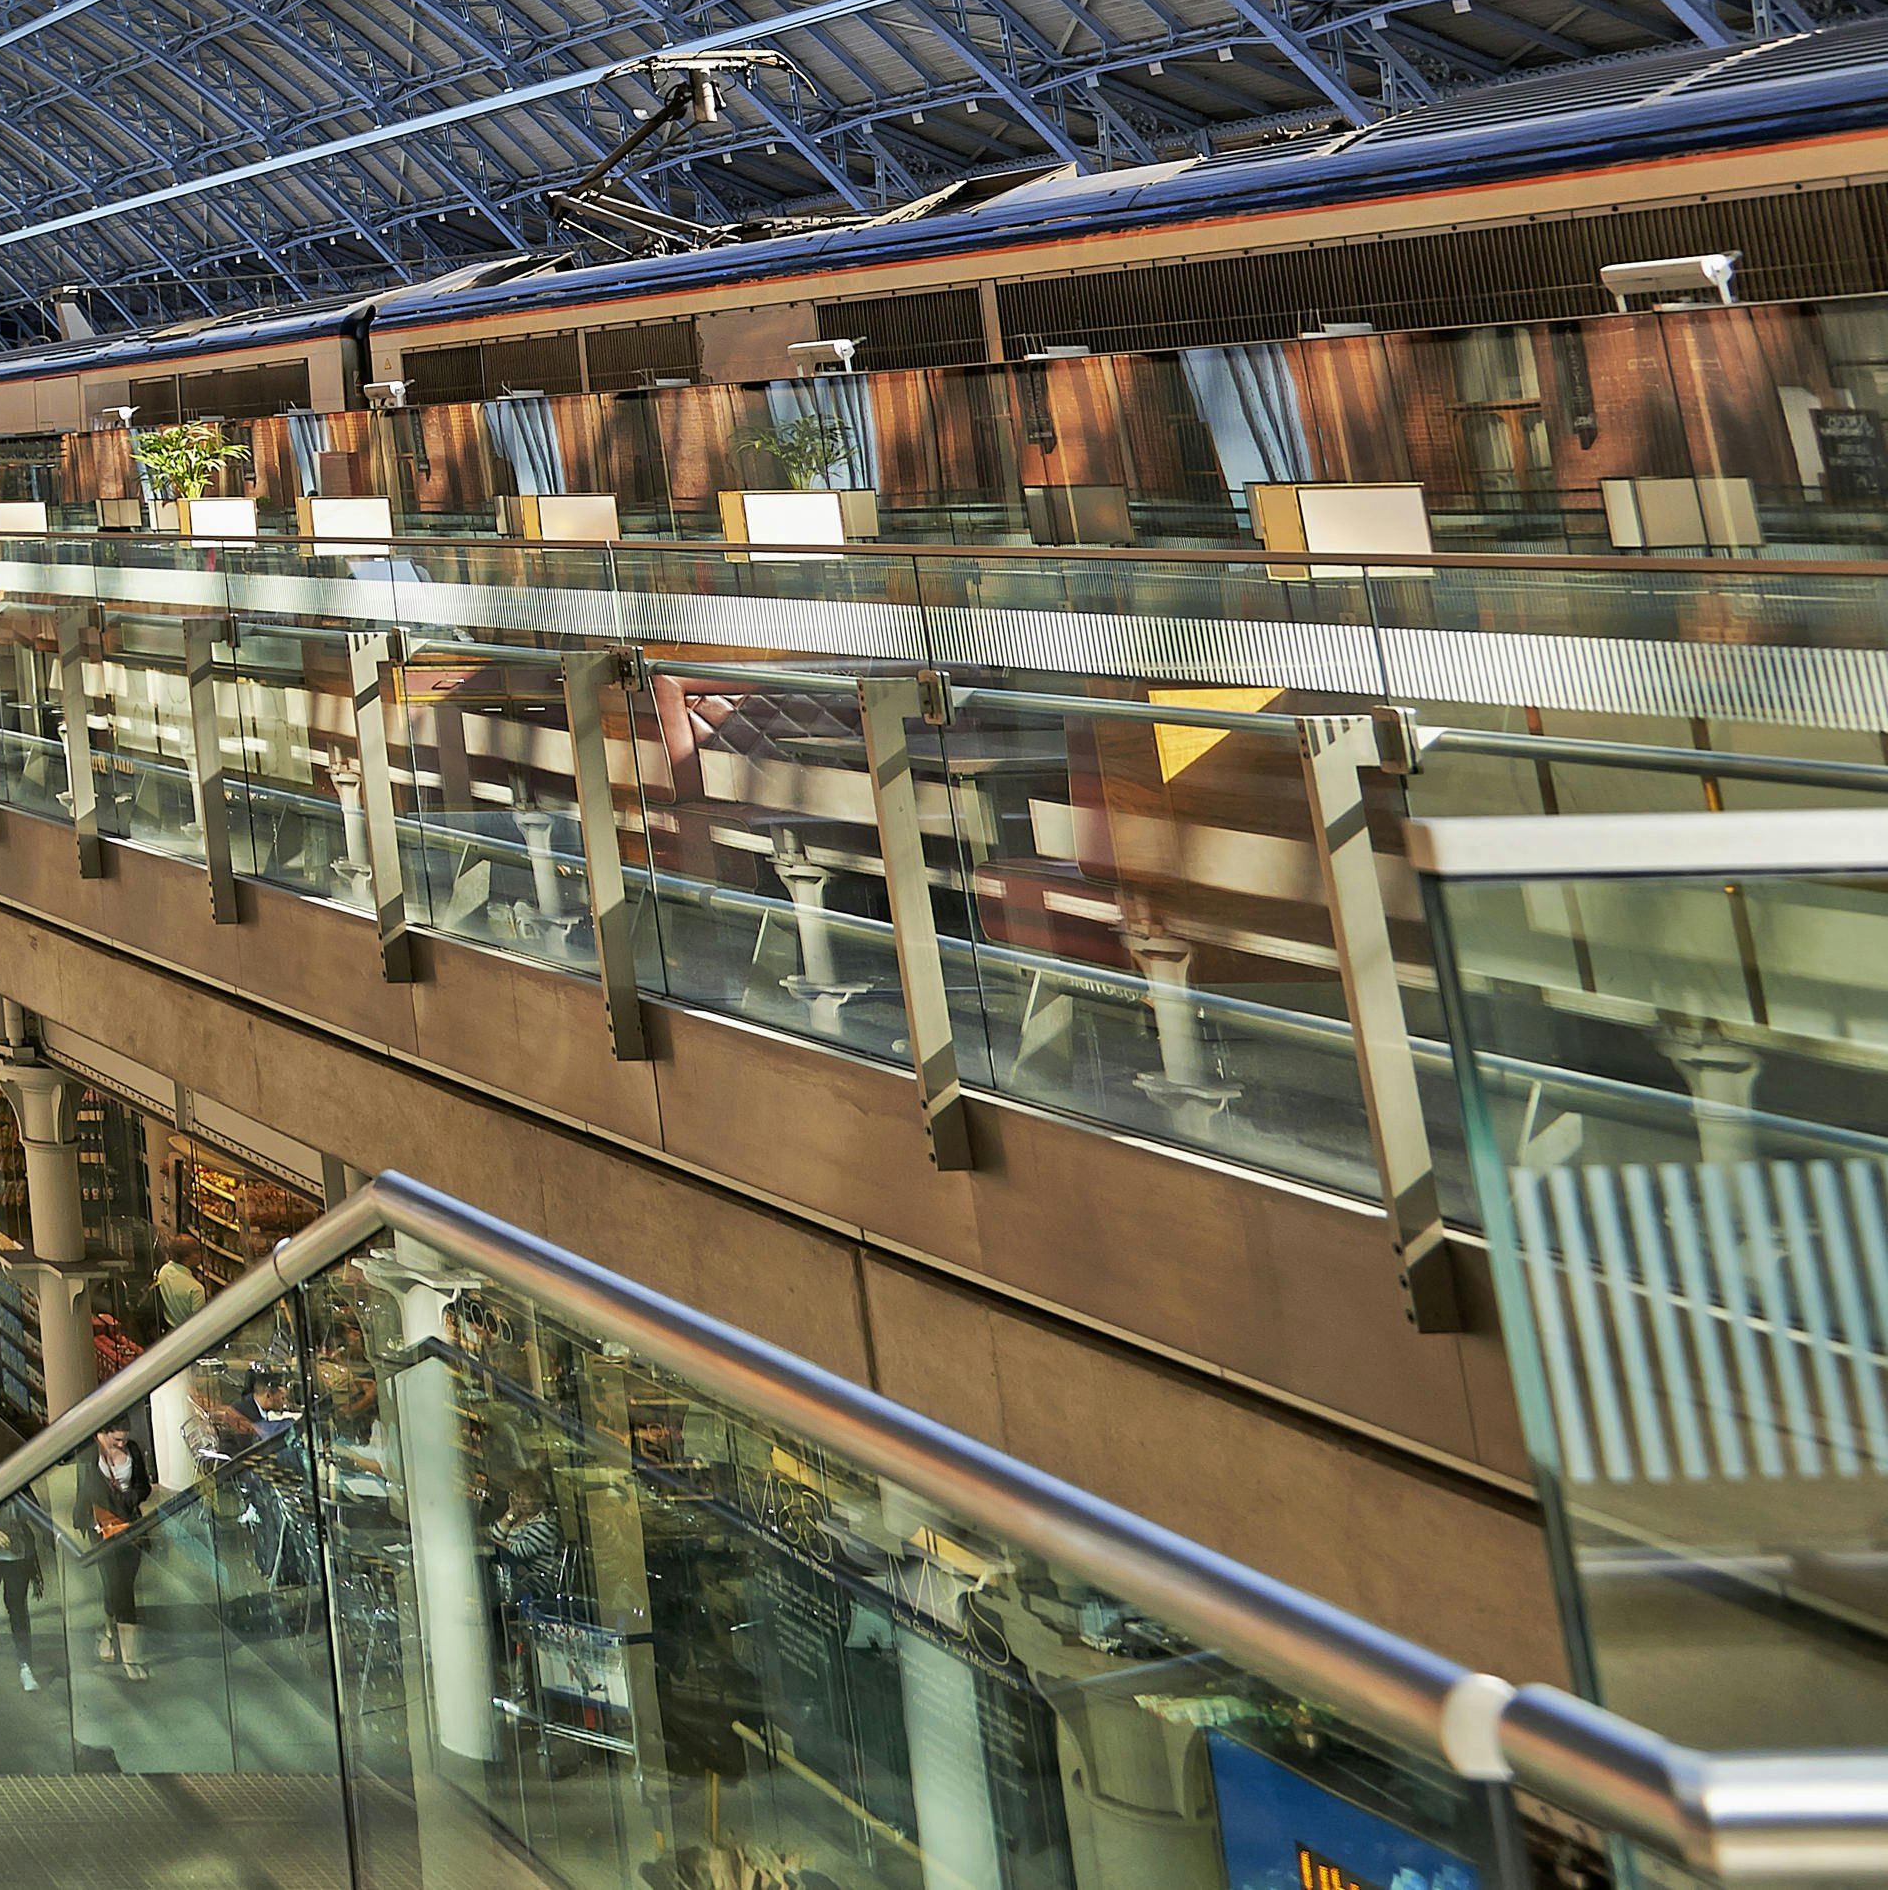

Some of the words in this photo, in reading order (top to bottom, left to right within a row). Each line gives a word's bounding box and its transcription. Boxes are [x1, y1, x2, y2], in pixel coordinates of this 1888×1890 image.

[461, 1296, 513, 1343] FOOD
[735, 1464, 833, 1563] M&S
[887, 1553, 1009, 1665] M&S
[969, 1650, 1020, 1690] Magasins
